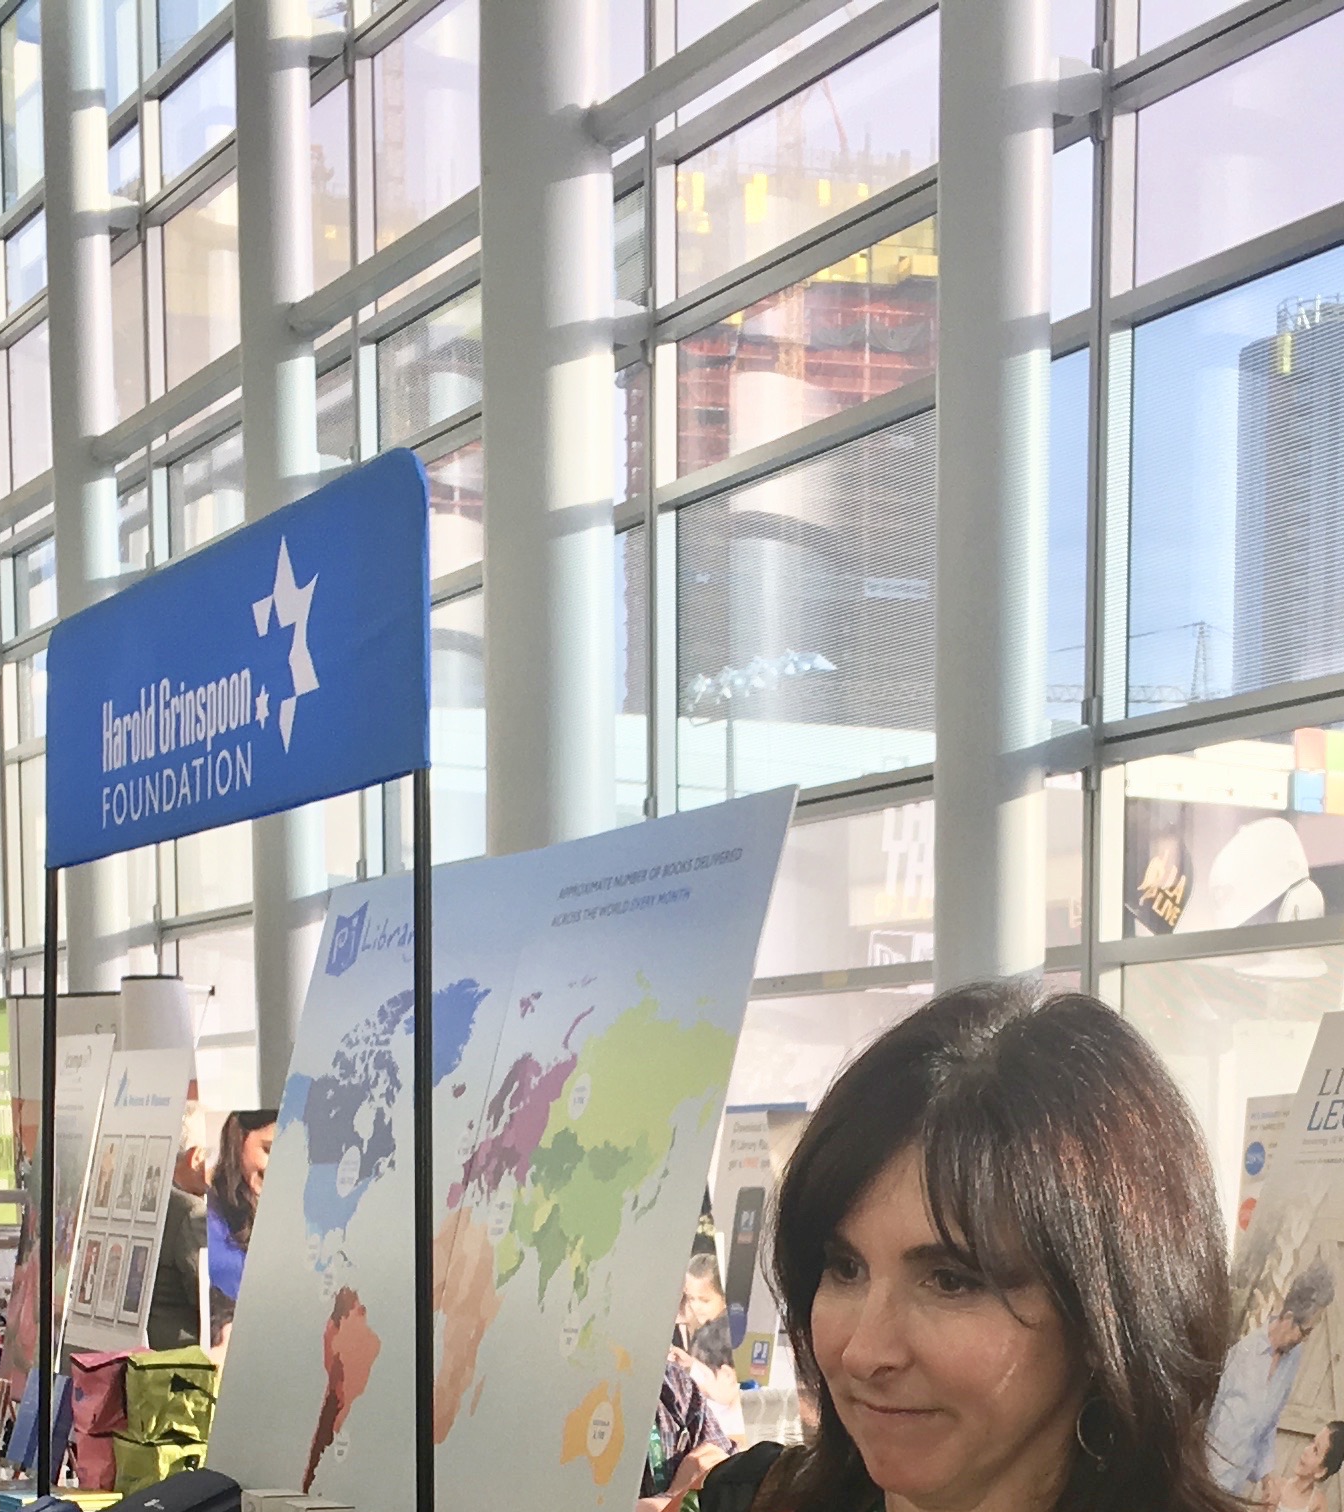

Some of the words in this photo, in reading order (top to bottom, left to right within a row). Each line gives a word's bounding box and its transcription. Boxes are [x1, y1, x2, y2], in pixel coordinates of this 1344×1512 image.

[103, 683, 155, 773] Harold
[159, 667, 251, 754] Grinspoon
[102, 741, 252, 829] FOUNDATION
[614, 869, 647, 887] NUMBER
[648, 865, 660, 881] OF
[662, 858, 692, 879] BOOKS
[693, 847, 743, 871] DELIVERED
[551, 909, 581, 927] ACROSS
[583, 906, 598, 921] THE
[599, 900, 630, 917] WORLD
[361, 916, 414, 963] Librar
